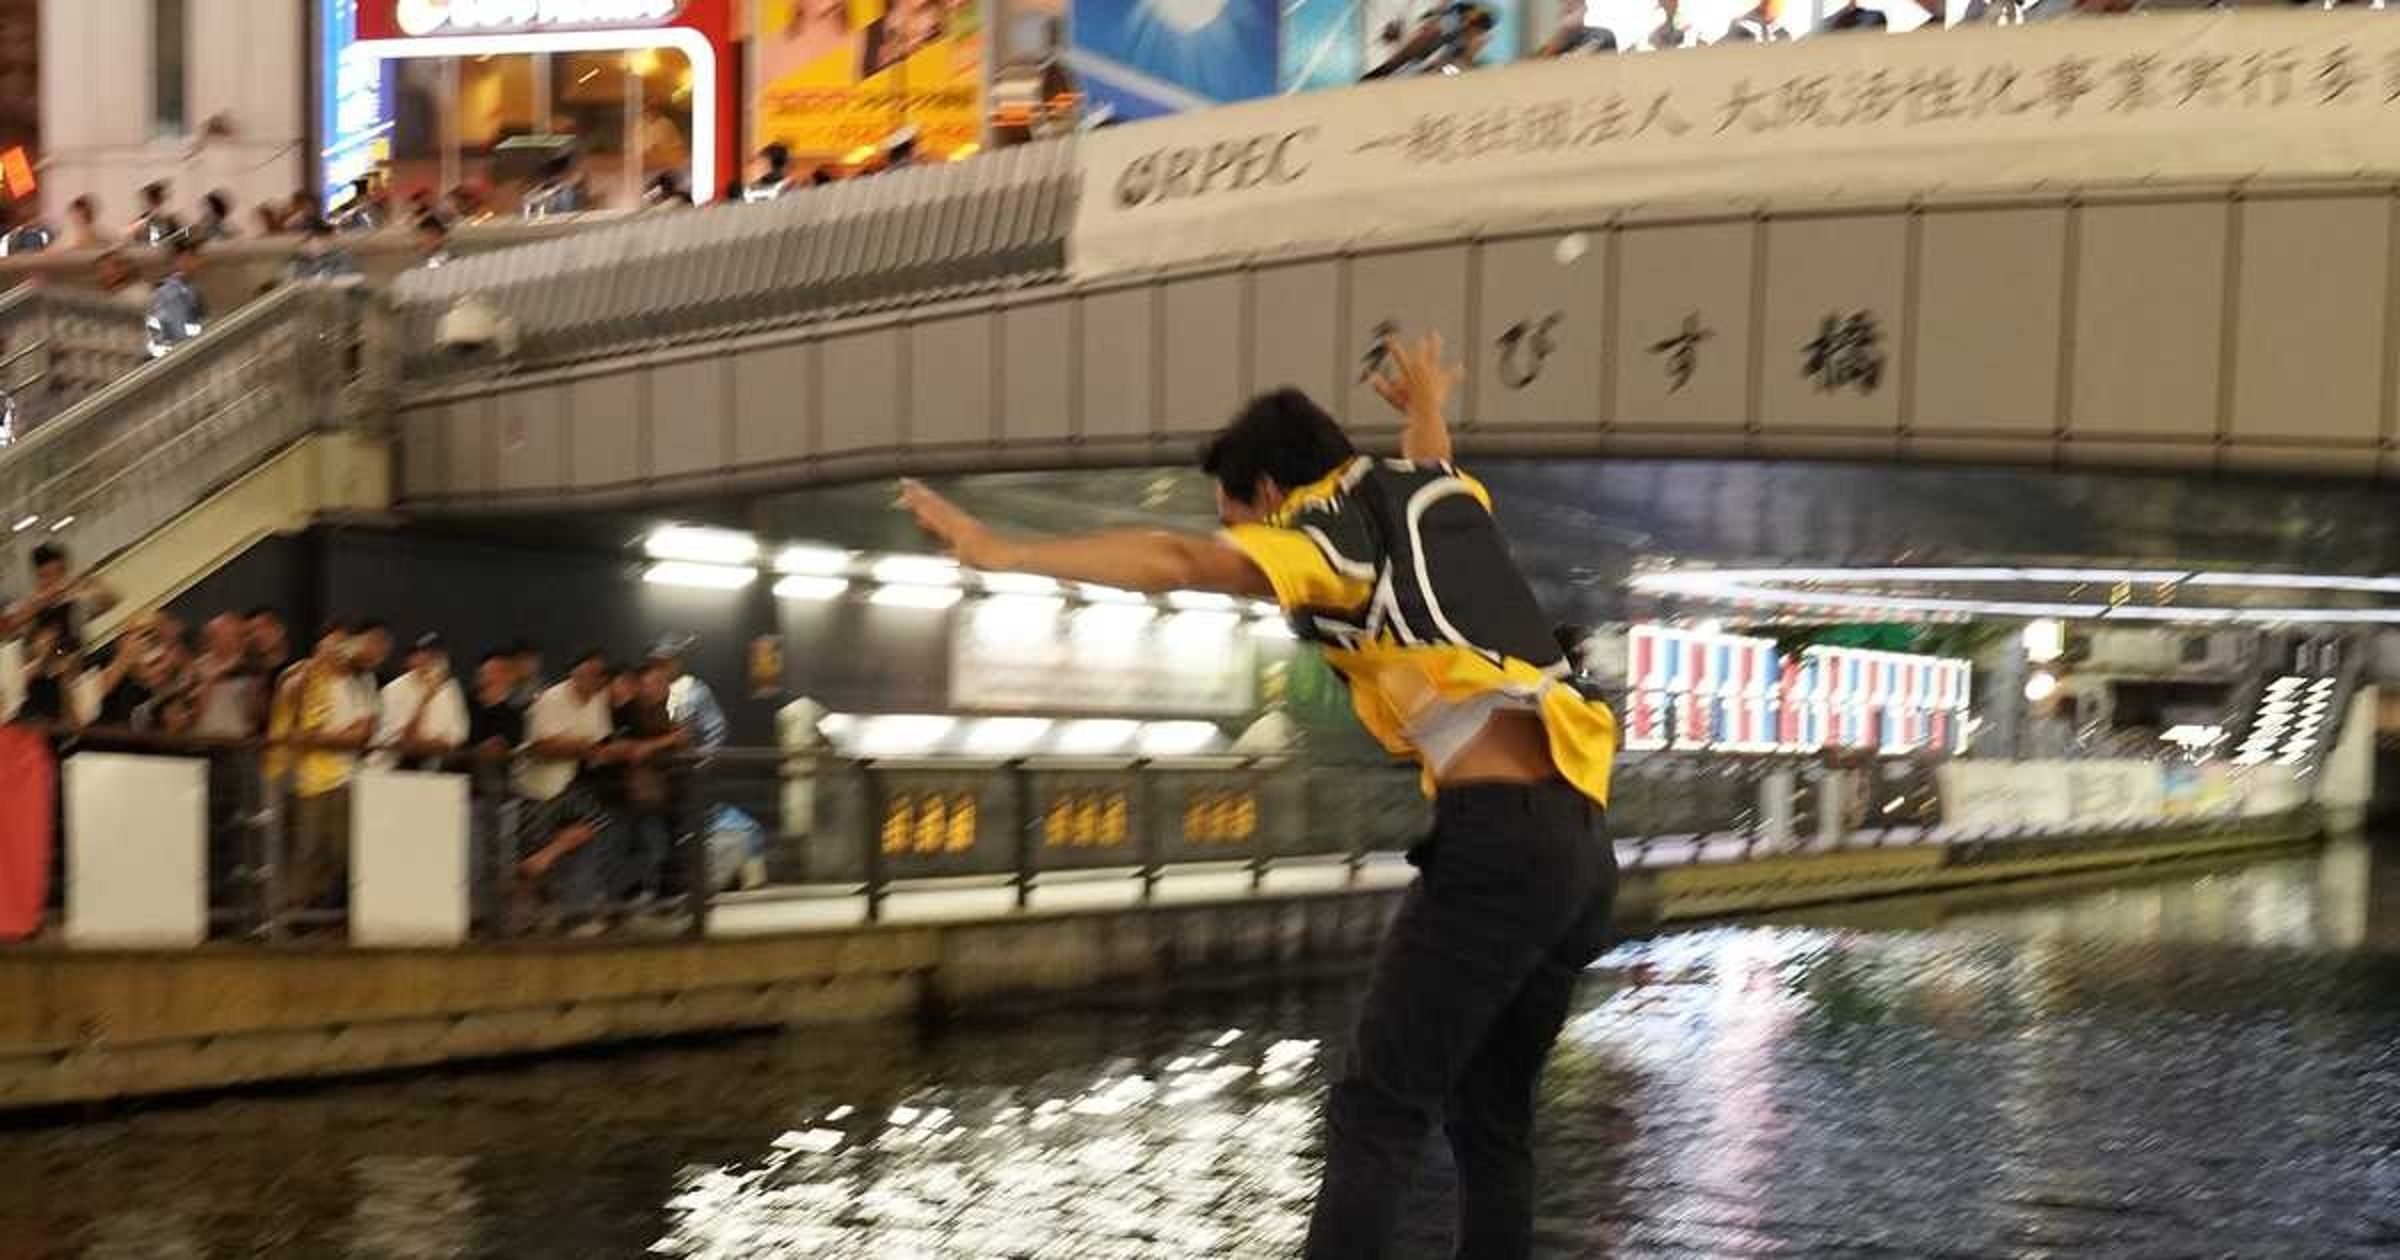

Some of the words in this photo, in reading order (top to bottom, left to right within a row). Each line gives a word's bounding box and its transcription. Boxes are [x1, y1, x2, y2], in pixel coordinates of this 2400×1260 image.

[1353, 90, 1695, 164] 一般社団法人
